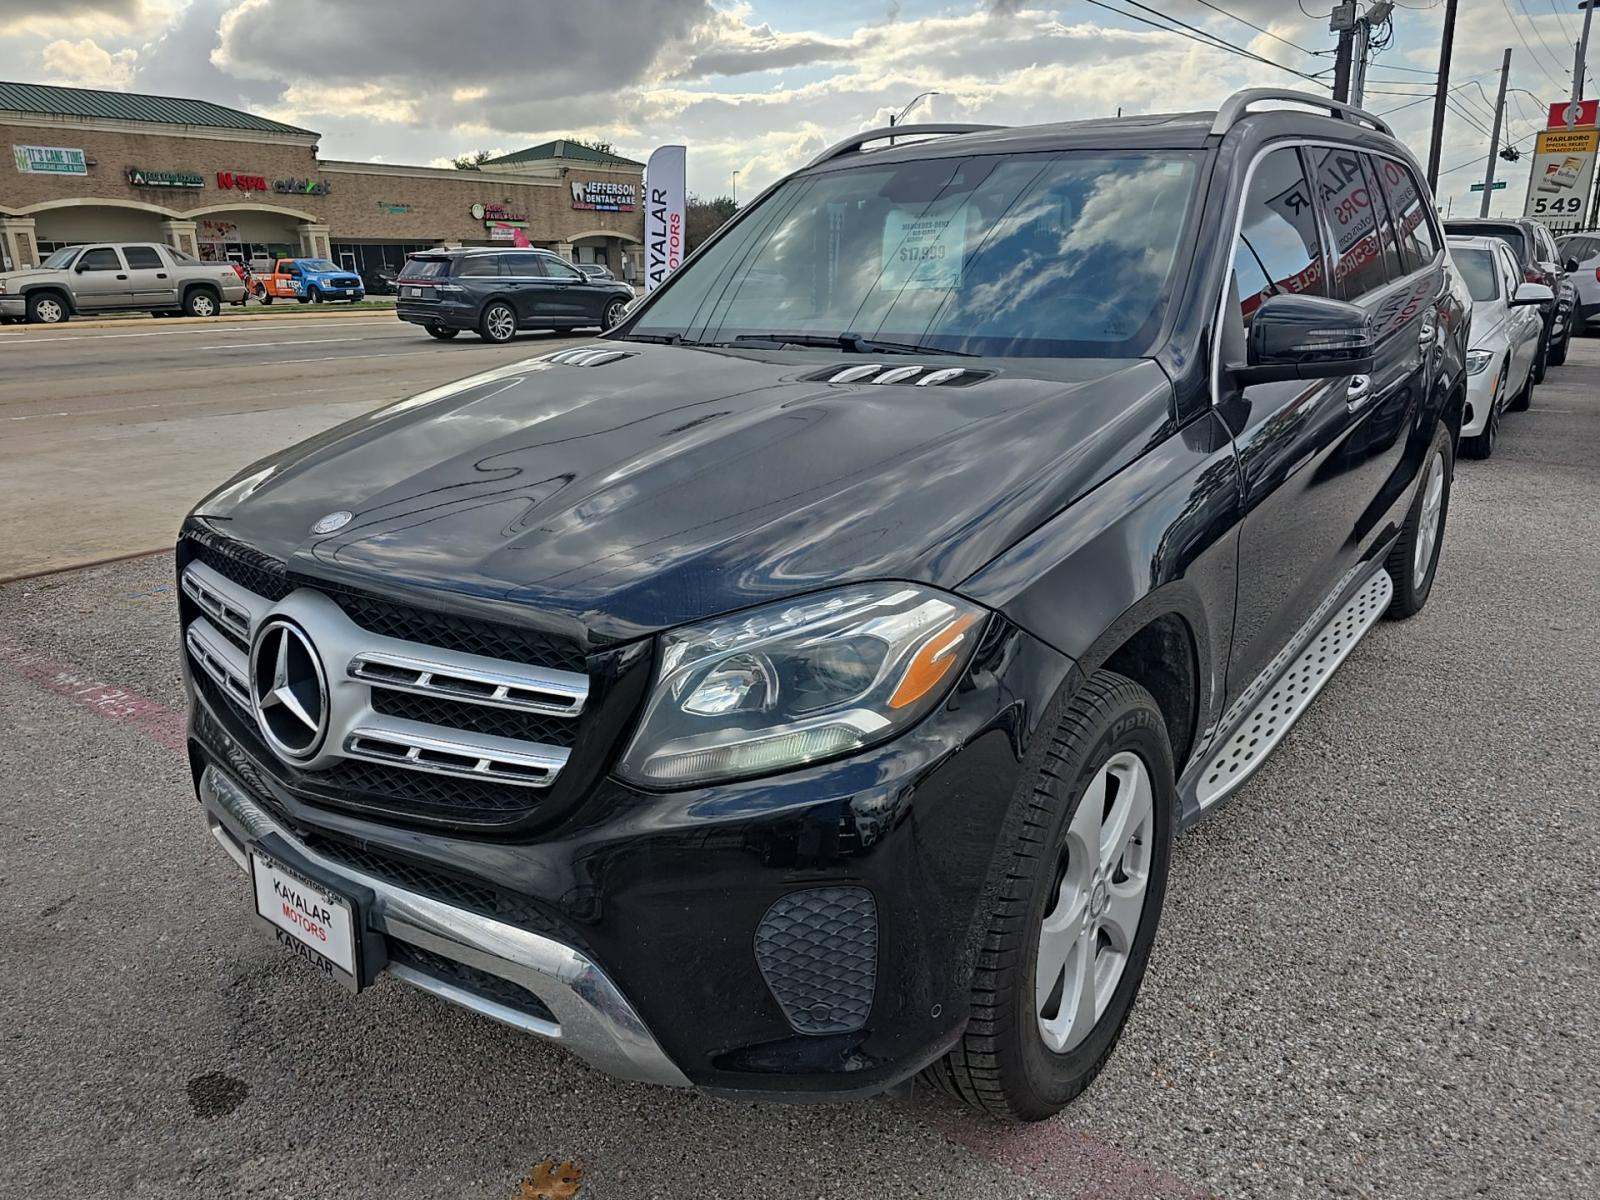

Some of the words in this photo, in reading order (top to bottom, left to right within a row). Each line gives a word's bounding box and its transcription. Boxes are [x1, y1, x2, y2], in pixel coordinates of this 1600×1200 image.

[26, 148, 43, 162] IT'S
[44, 149, 64, 162] CANE
[65, 151, 83, 164] TIME
[586, 181, 636, 195] JEFFERSON
[586, 194, 613, 203] DENTAL
[616, 196, 636, 204] CARE
[273, 878, 332, 928] KAYALAR
[282, 902, 327, 942] MOTORS
[275, 928, 334, 977] KAYALAR
